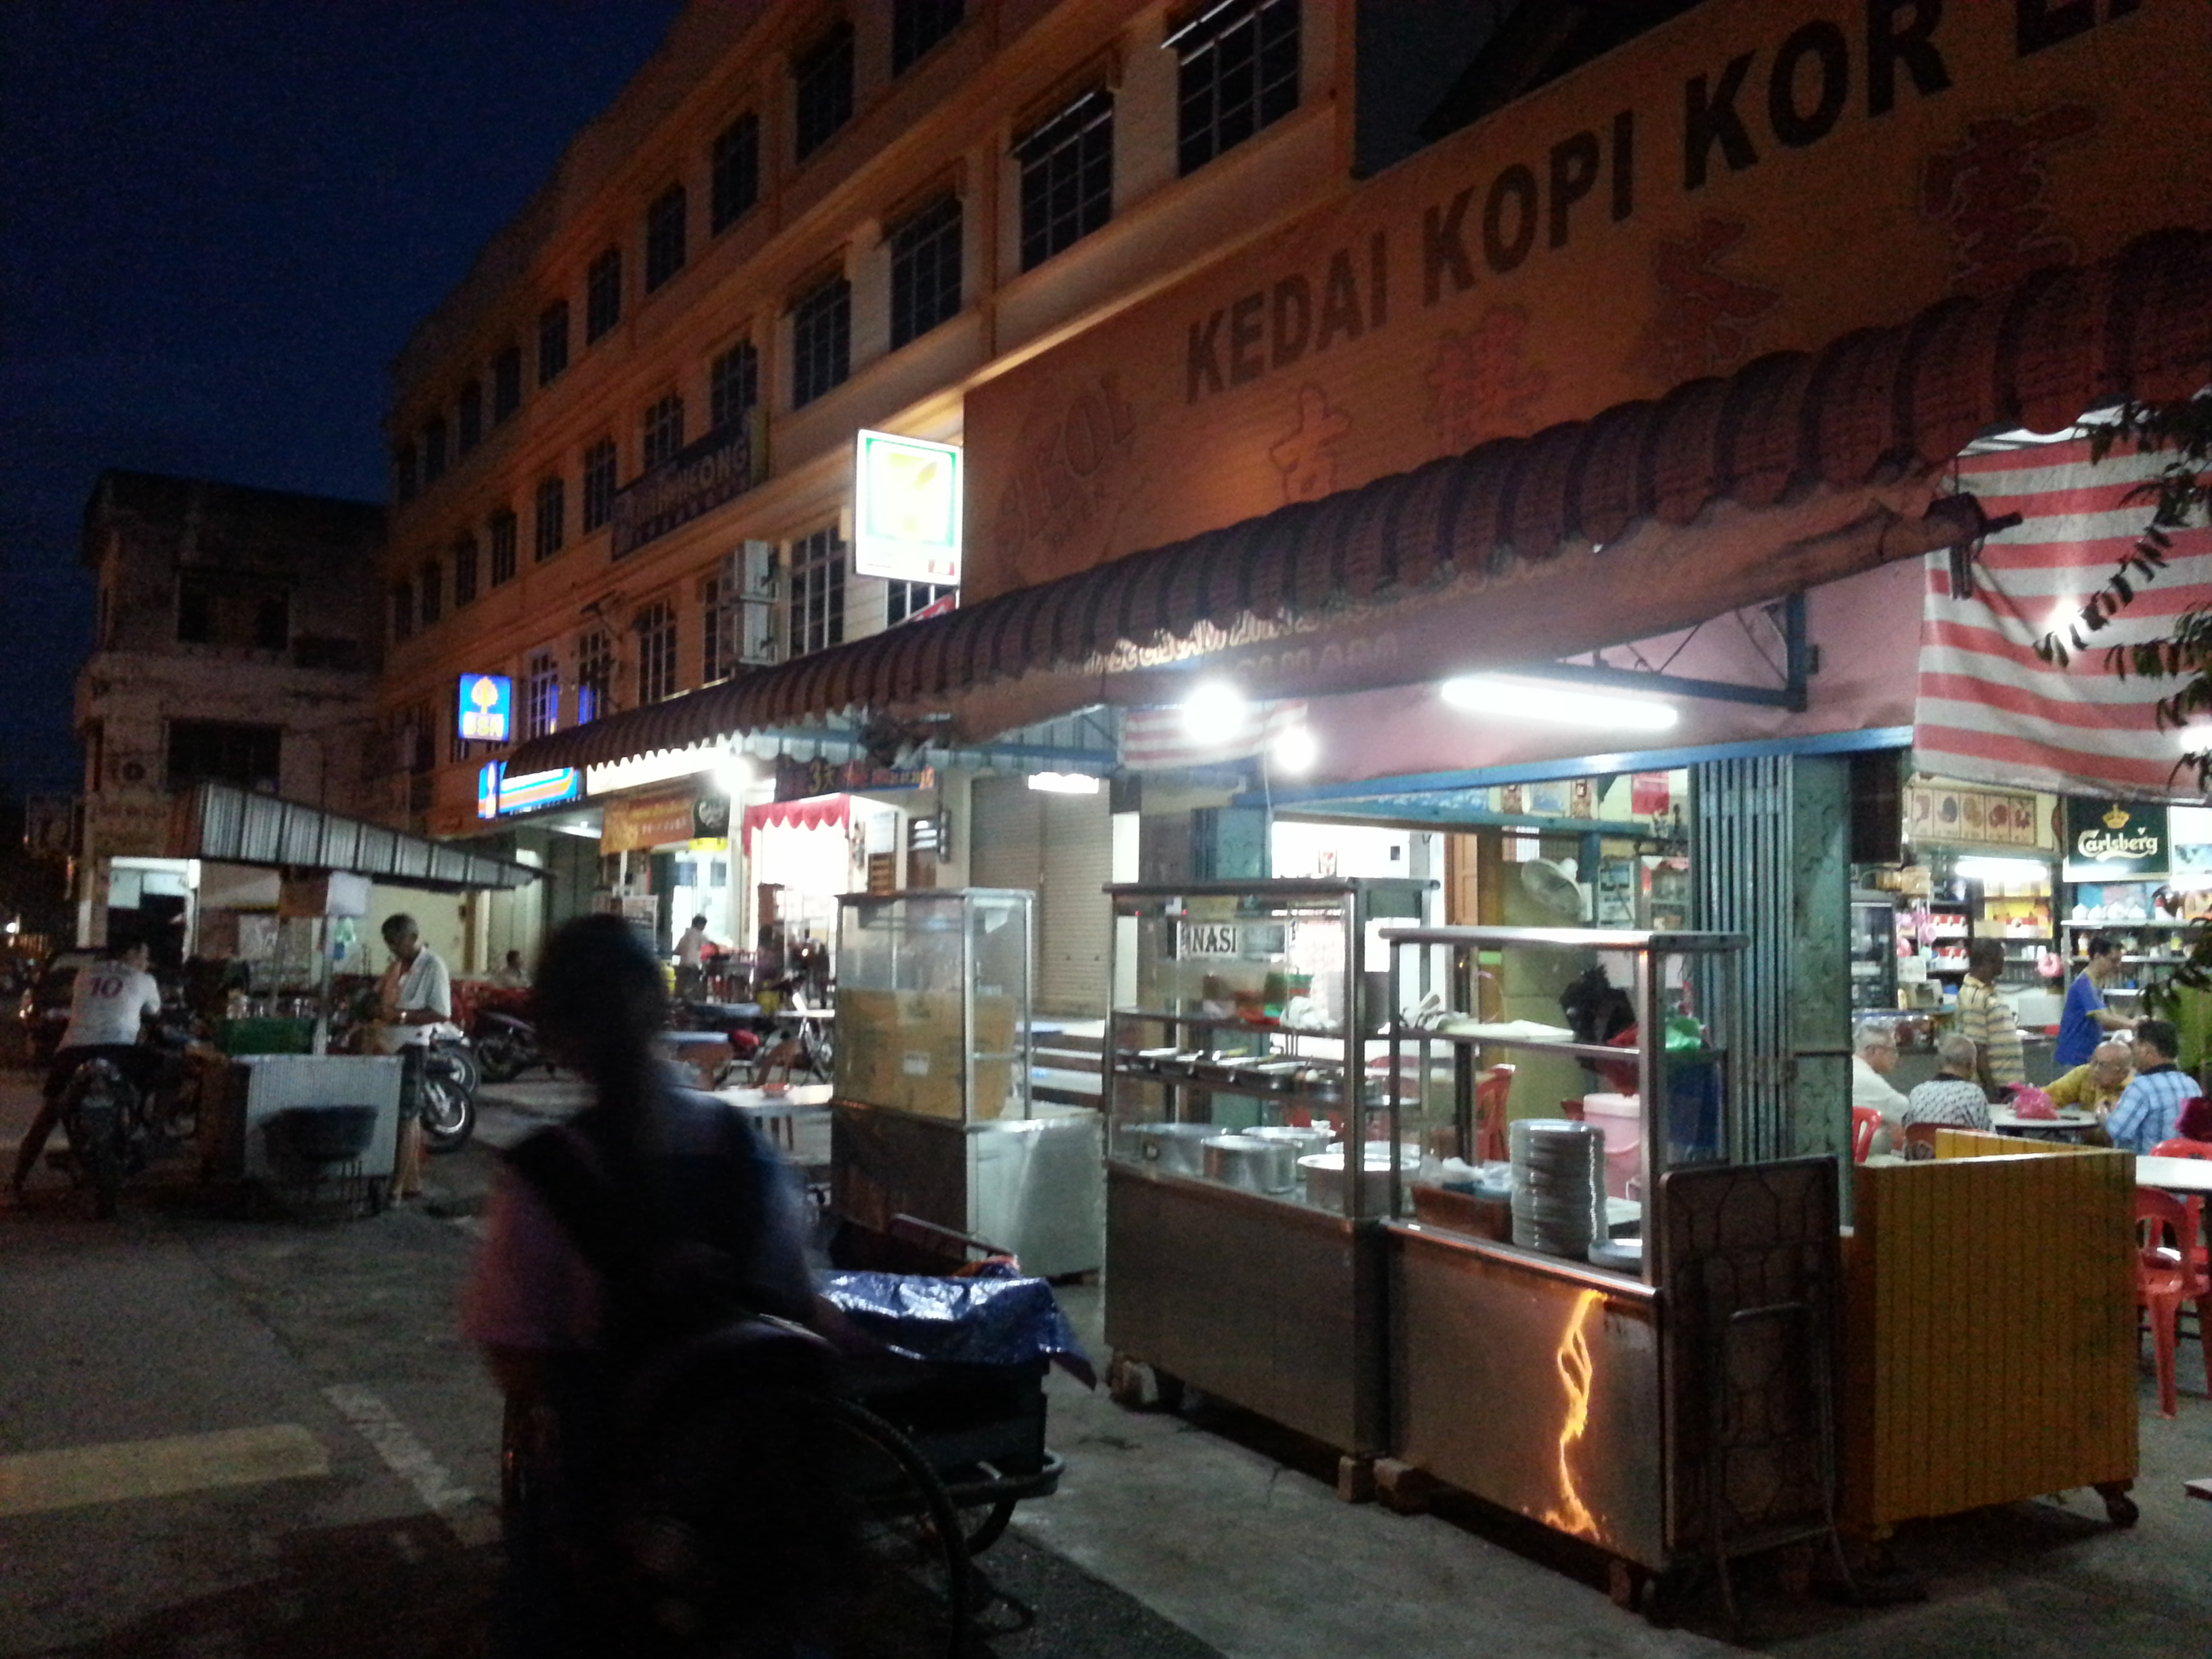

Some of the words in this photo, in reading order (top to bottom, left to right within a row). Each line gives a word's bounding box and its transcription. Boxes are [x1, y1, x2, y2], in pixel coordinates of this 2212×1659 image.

[1186, 231, 1388, 405] KEDAI
[1424, 108, 1633, 307] KOPI
[1684, 0, 1952, 190] KOR
[2078, 829, 2158, 861] Carlsberg
[1192, 926, 1237, 953] NASI
[88, 977, 123, 998] 10
